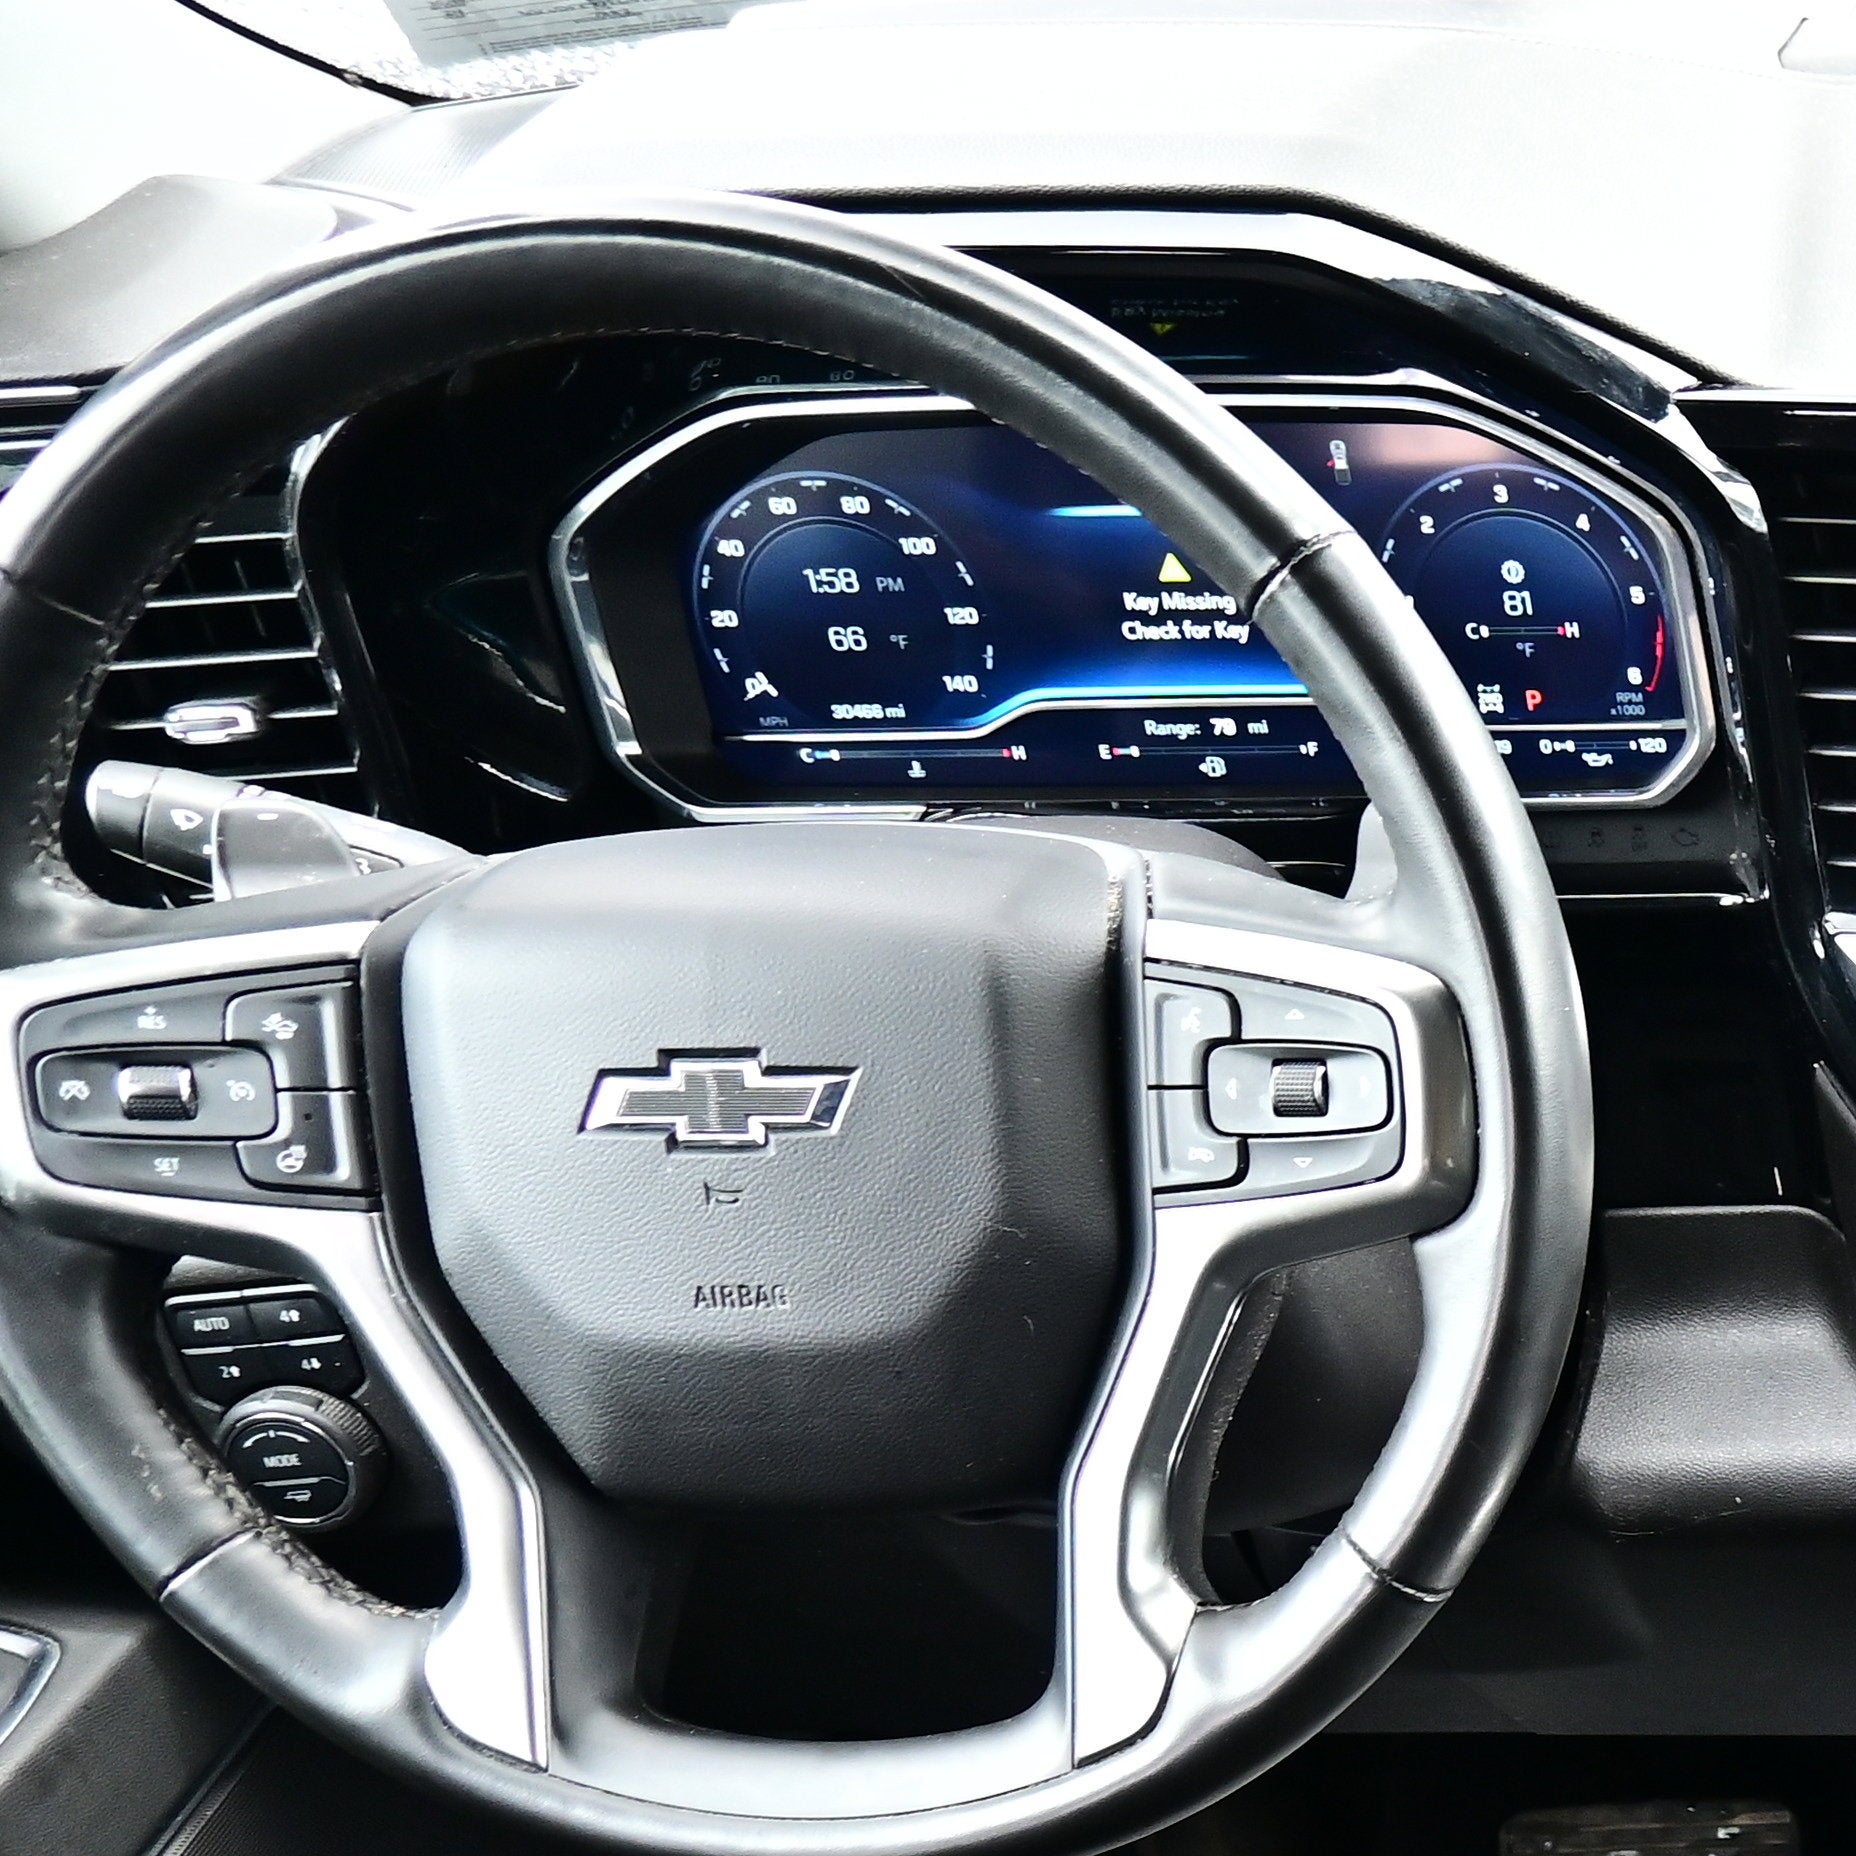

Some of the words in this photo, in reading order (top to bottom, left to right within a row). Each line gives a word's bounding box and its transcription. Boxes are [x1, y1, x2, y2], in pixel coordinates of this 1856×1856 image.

[1493, 484, 1509, 503] 3
[768, 497, 797, 515] 60
[840, 496, 870, 514] 80
[1419, 515, 1435, 534] 2
[1575, 513, 1591, 531] 4
[717, 539, 745, 557] 40
[899, 537, 937, 555] 100
[802, 568, 860, 593] 1:58
[876, 576, 905, 591] PM
[1122, 592, 1159, 616] Key
[1161, 592, 1237, 615] Missing
[1502, 590, 1534, 616] 81
[1629, 586, 1645, 605] 5
[710, 610, 738, 628] 20
[944, 607, 980, 625] 120
[828, 626, 868, 651] 66
[1121, 620, 1182, 640] Check
[1182, 619, 1212, 639] for
[1213, 620, 1250, 644] Key
[1465, 623, 1480, 640] C
[1564, 622, 1580, 638] H
[942, 675, 979, 692] 140
[1627, 666, 1643, 685] 6
[1525, 690, 1543, 711] P
[1616, 692, 1643, 703] RPM
[885, 703, 906, 718] mi
[1610, 704, 1646, 716] x1000
[759, 716, 789, 728] MPH
[1144, 719, 1202, 740] Range:
[1247, 719, 1269, 734] mi
[801, 746, 815, 762] C
[1011, 746, 1027, 761] H
[1099, 745, 1112, 760] E
[1307, 742, 1319, 756] F
[1539, 739, 1552, 754] 0
[1638, 738, 1667, 753] 120
[154, 1156, 181, 1170] SET
[693, 1284, 788, 1309] AIRBAG
[193, 1317, 230, 1332] AUTO
[263, 1453, 302, 1468] MODE
